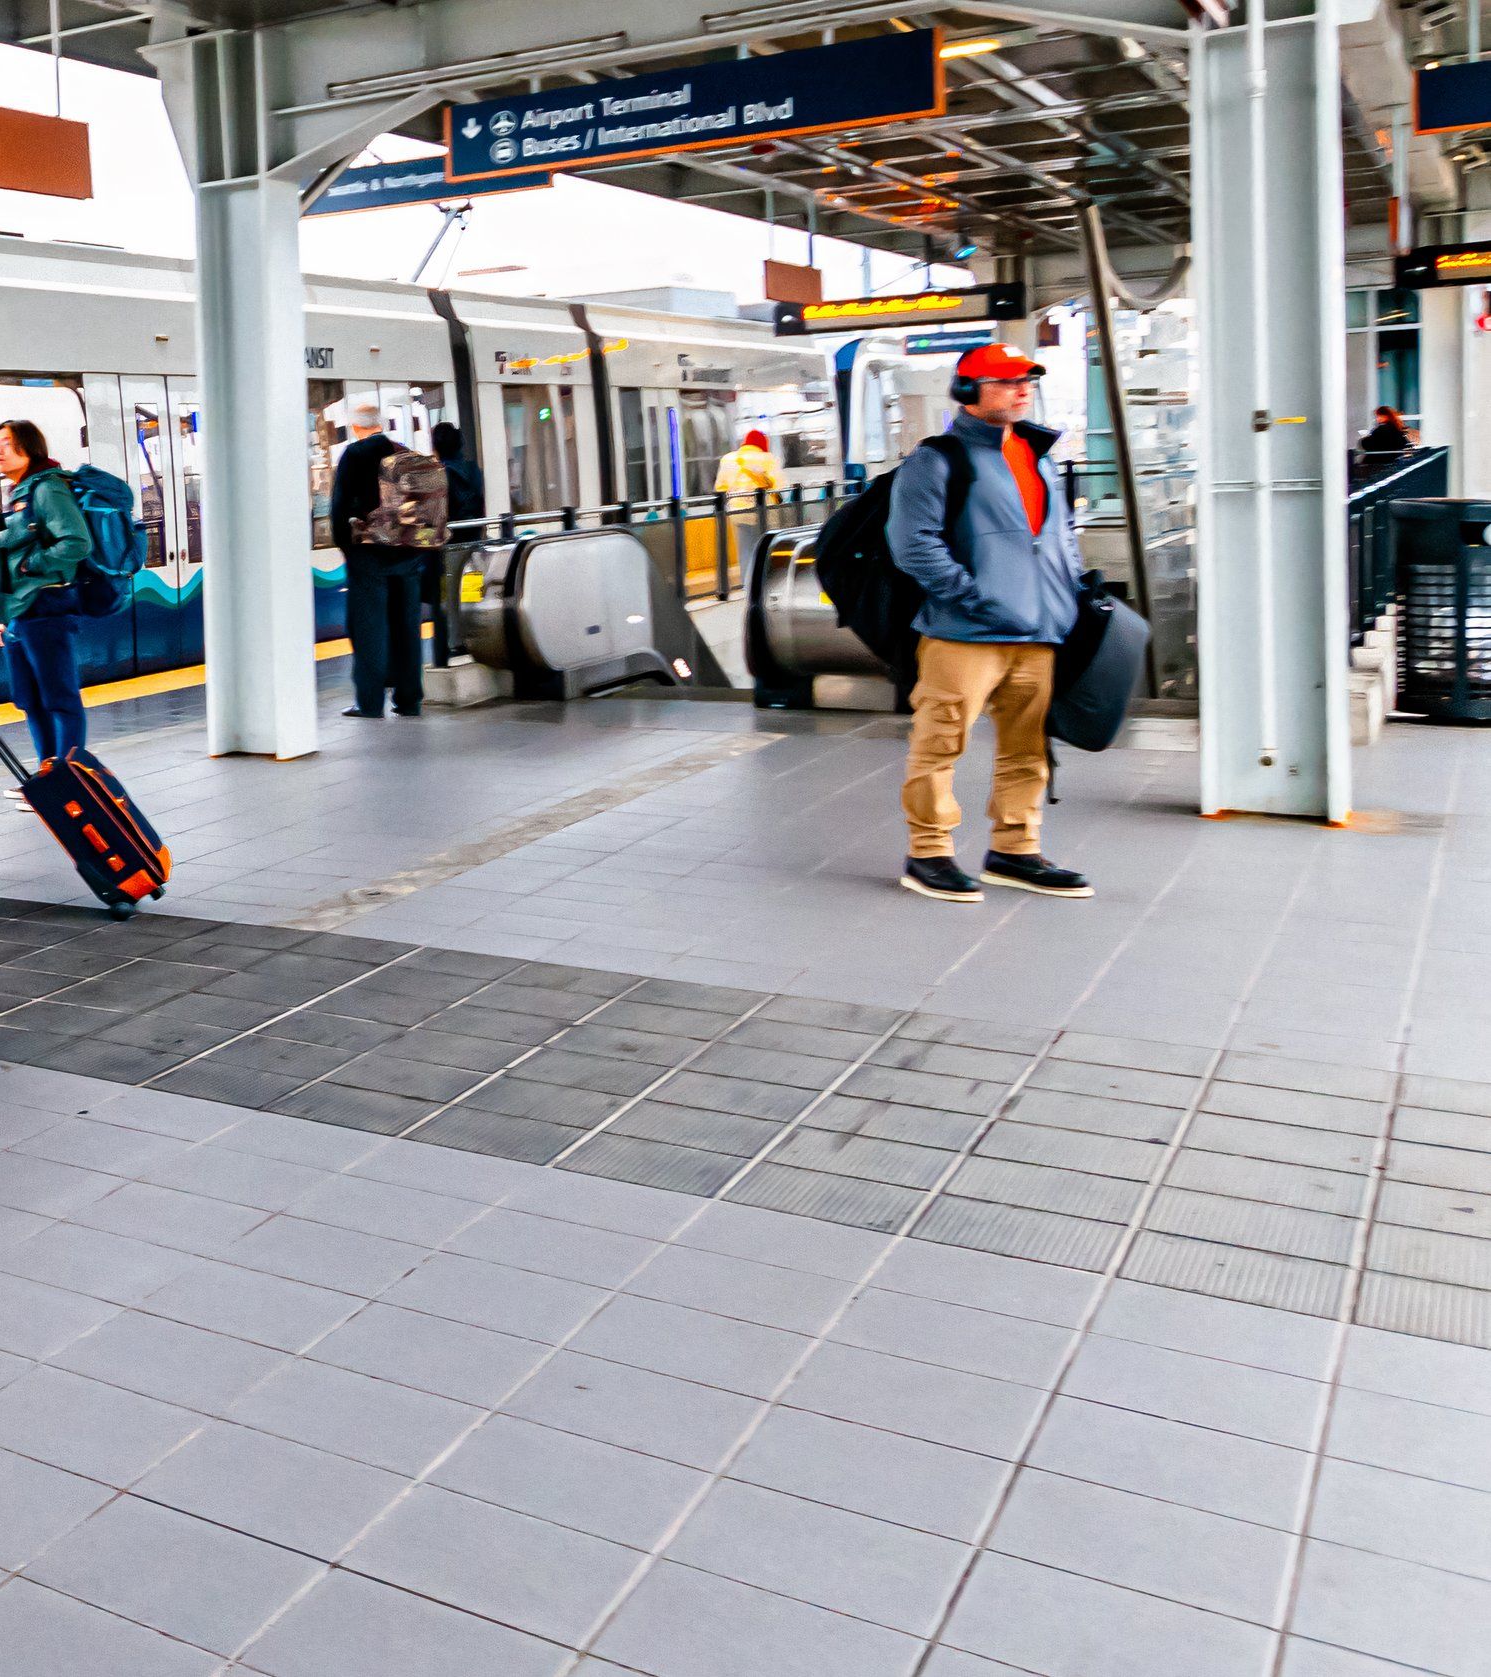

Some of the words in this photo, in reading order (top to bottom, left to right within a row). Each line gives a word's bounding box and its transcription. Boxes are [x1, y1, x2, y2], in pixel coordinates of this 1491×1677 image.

[520, 102, 595, 130] Airport
[599, 83, 692, 116] Terminal
[521, 134, 581, 157] Buses
[582, 128, 596, 150] /
[597, 105, 736, 146] International
[743, 97, 794, 125] Blvd
